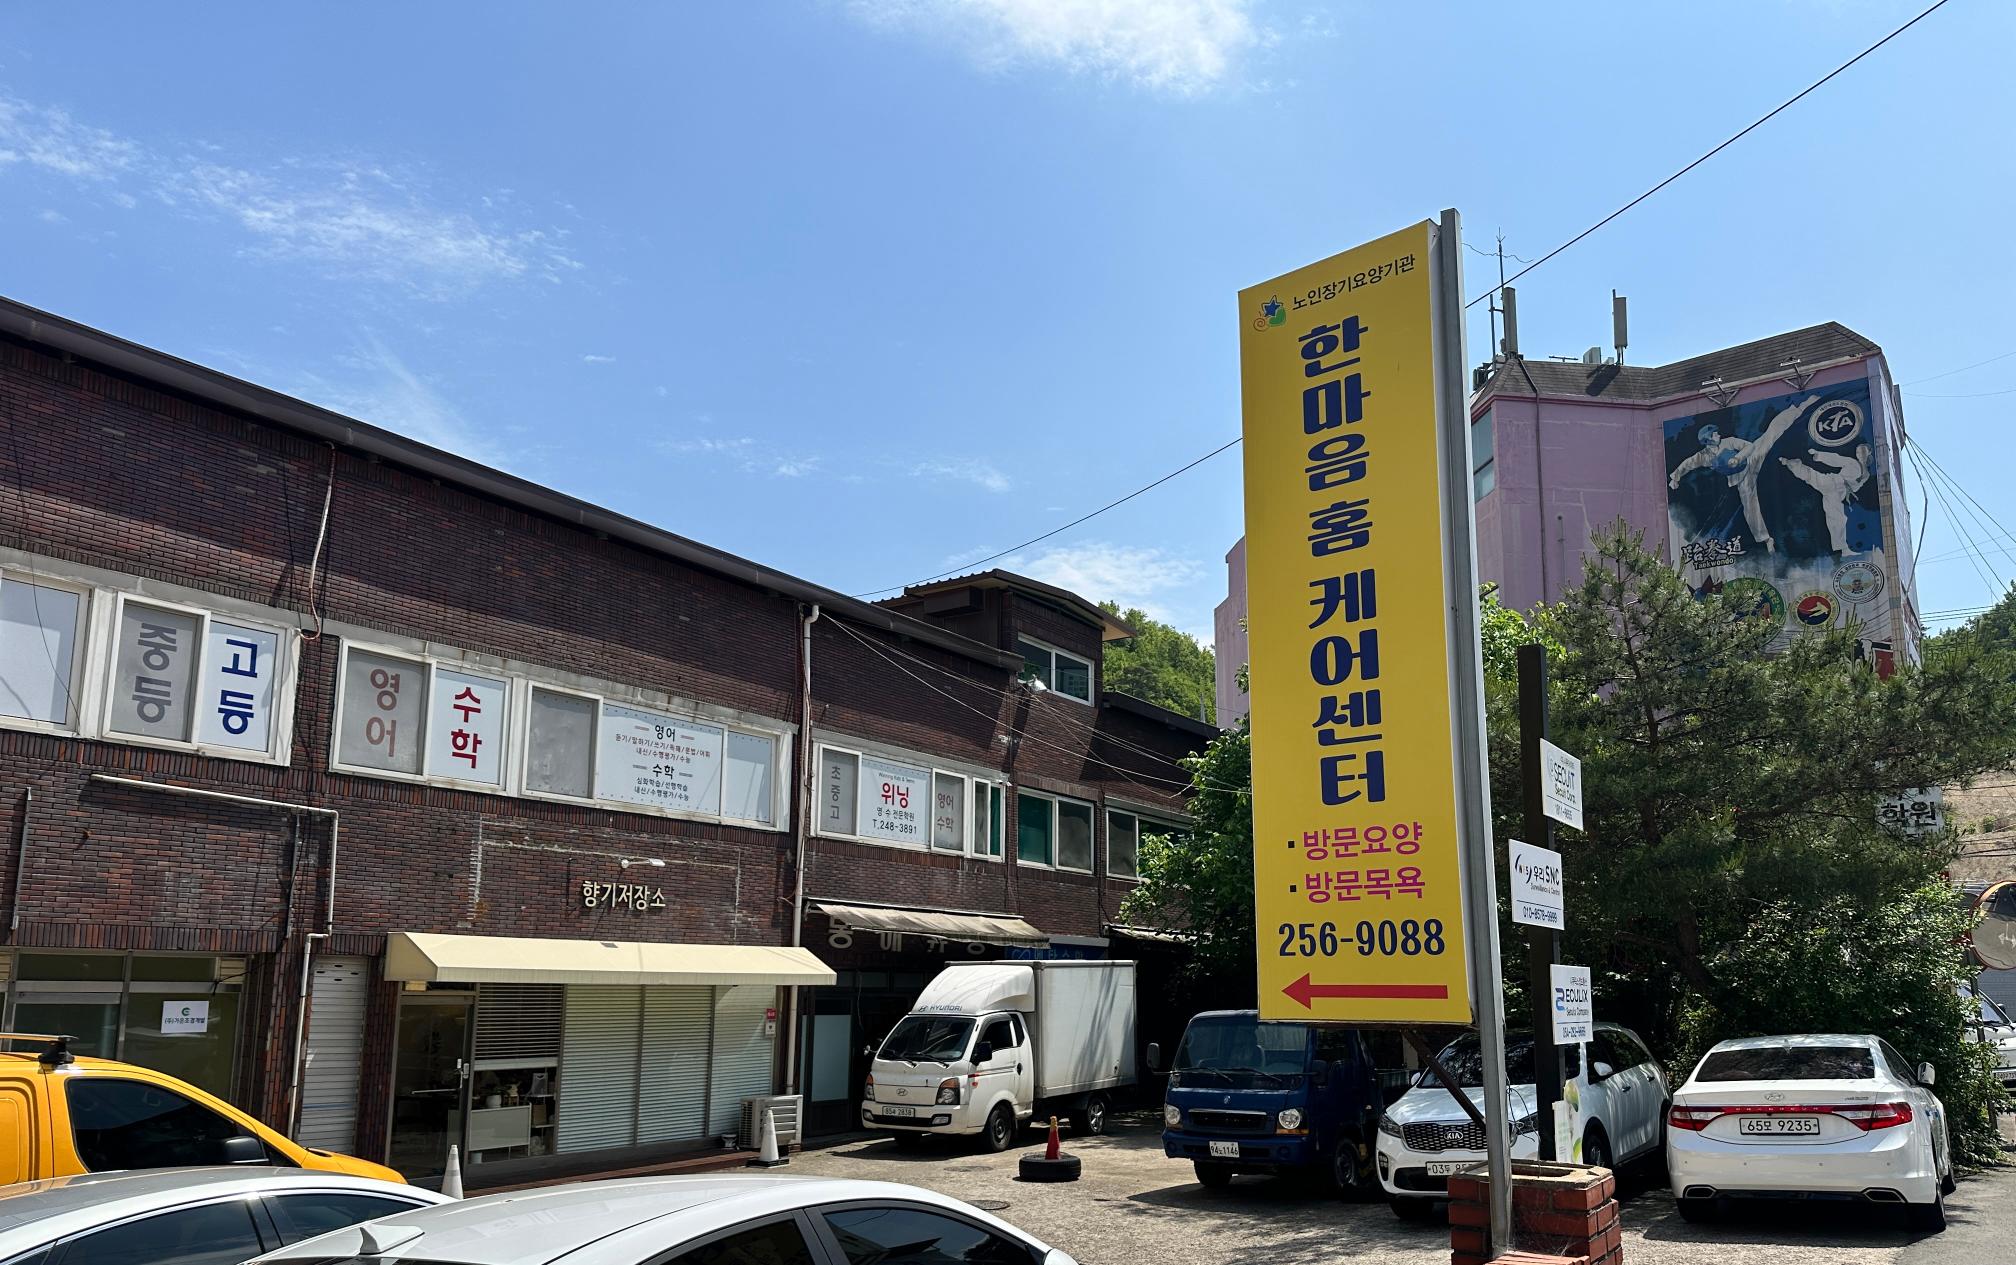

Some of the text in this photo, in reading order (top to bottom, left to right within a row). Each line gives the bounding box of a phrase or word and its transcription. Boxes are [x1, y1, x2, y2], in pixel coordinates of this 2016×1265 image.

[1291, 253, 1416, 312] 노인장기요양기관
[1818, 410, 1854, 432] KTA
[1694, 557, 1735, 570] Taekwondo
[131, 622, 178, 724] 중등
[217, 638, 259, 735] 고등
[365, 668, 401, 758] 영어
[450, 686, 482, 769] 수학
[654, 724, 676, 742] 영어
[652, 763, 675, 780] 수학
[881, 782, 909, 809] 위닝
[937, 793, 954, 810] 영어
[937, 816, 954, 833] 수학
[1303, 820, 1424, 861] 방문요양
[582, 880, 667, 911] 향기저장소
[1304, 865, 1426, 904] 방문목욕
[1278, 918, 1446, 957] 256-9088
[1747, 1119, 1812, 1132] 65모 9235
